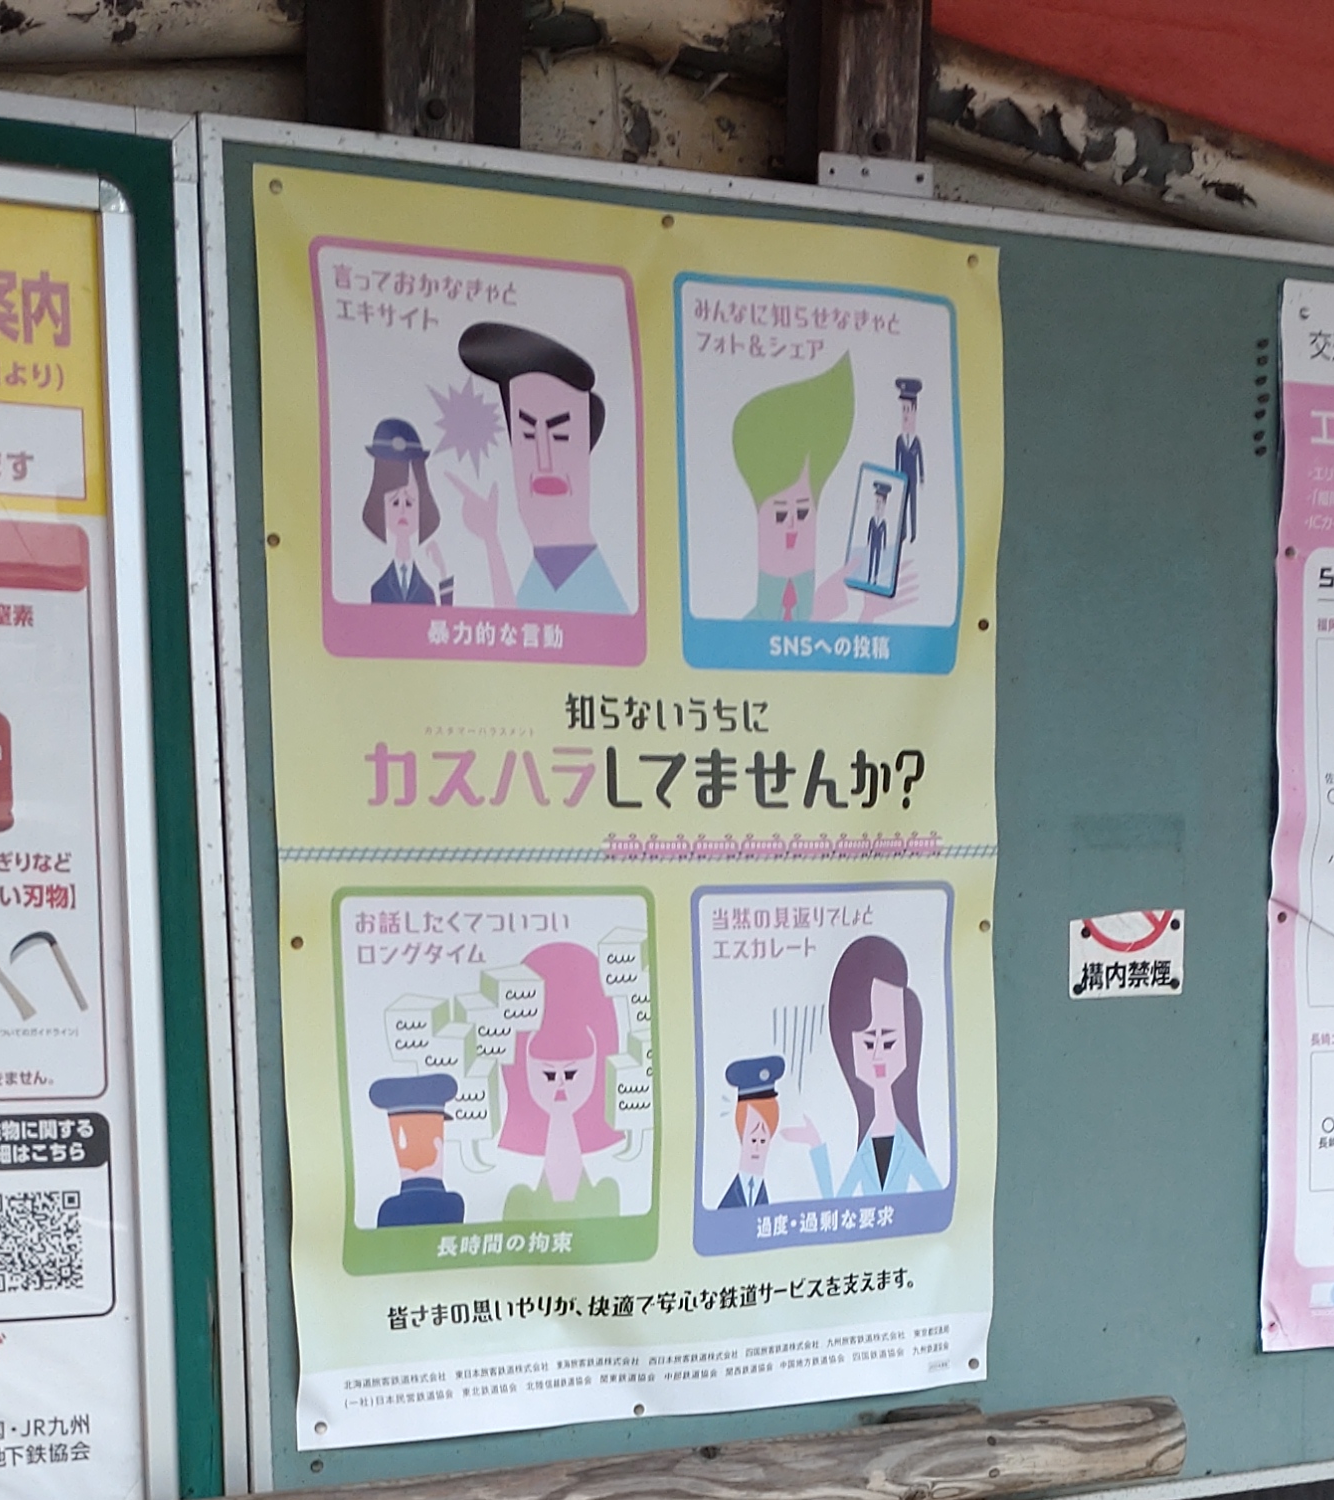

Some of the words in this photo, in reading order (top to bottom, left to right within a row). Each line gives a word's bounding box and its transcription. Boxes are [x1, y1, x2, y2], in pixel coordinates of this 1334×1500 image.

[331, 262, 518, 306] 言っておかなきゃと
[335, 299, 439, 331] エキサイト
[693, 298, 902, 336] みんなに知らせなきゃと
[696, 331, 825, 361] フォト&シェア
[427, 621, 565, 650] 暴力的な言動
[769, 632, 891, 661] SNSへの投稿
[565, 692, 771, 733] 知らないうちに
[364, 742, 926, 810] カスハラしてませんか?
[354, 910, 570, 936] お話したくてついつい
[711, 904, 875, 931] 当然の見返りでしょと
[357, 941, 487, 966] ロングタイム
[713, 935, 818, 961] エスカレート
[1081, 960, 1172, 991] 構内禁煙
[756, 1206, 895, 1239] 過度・過剰な要求
[436, 1230, 574, 1258] 長時間の拘束
[387, 1267, 915, 1331] 皆さまの思いやりが、快適で安心な鉄道サービスを支えます。
